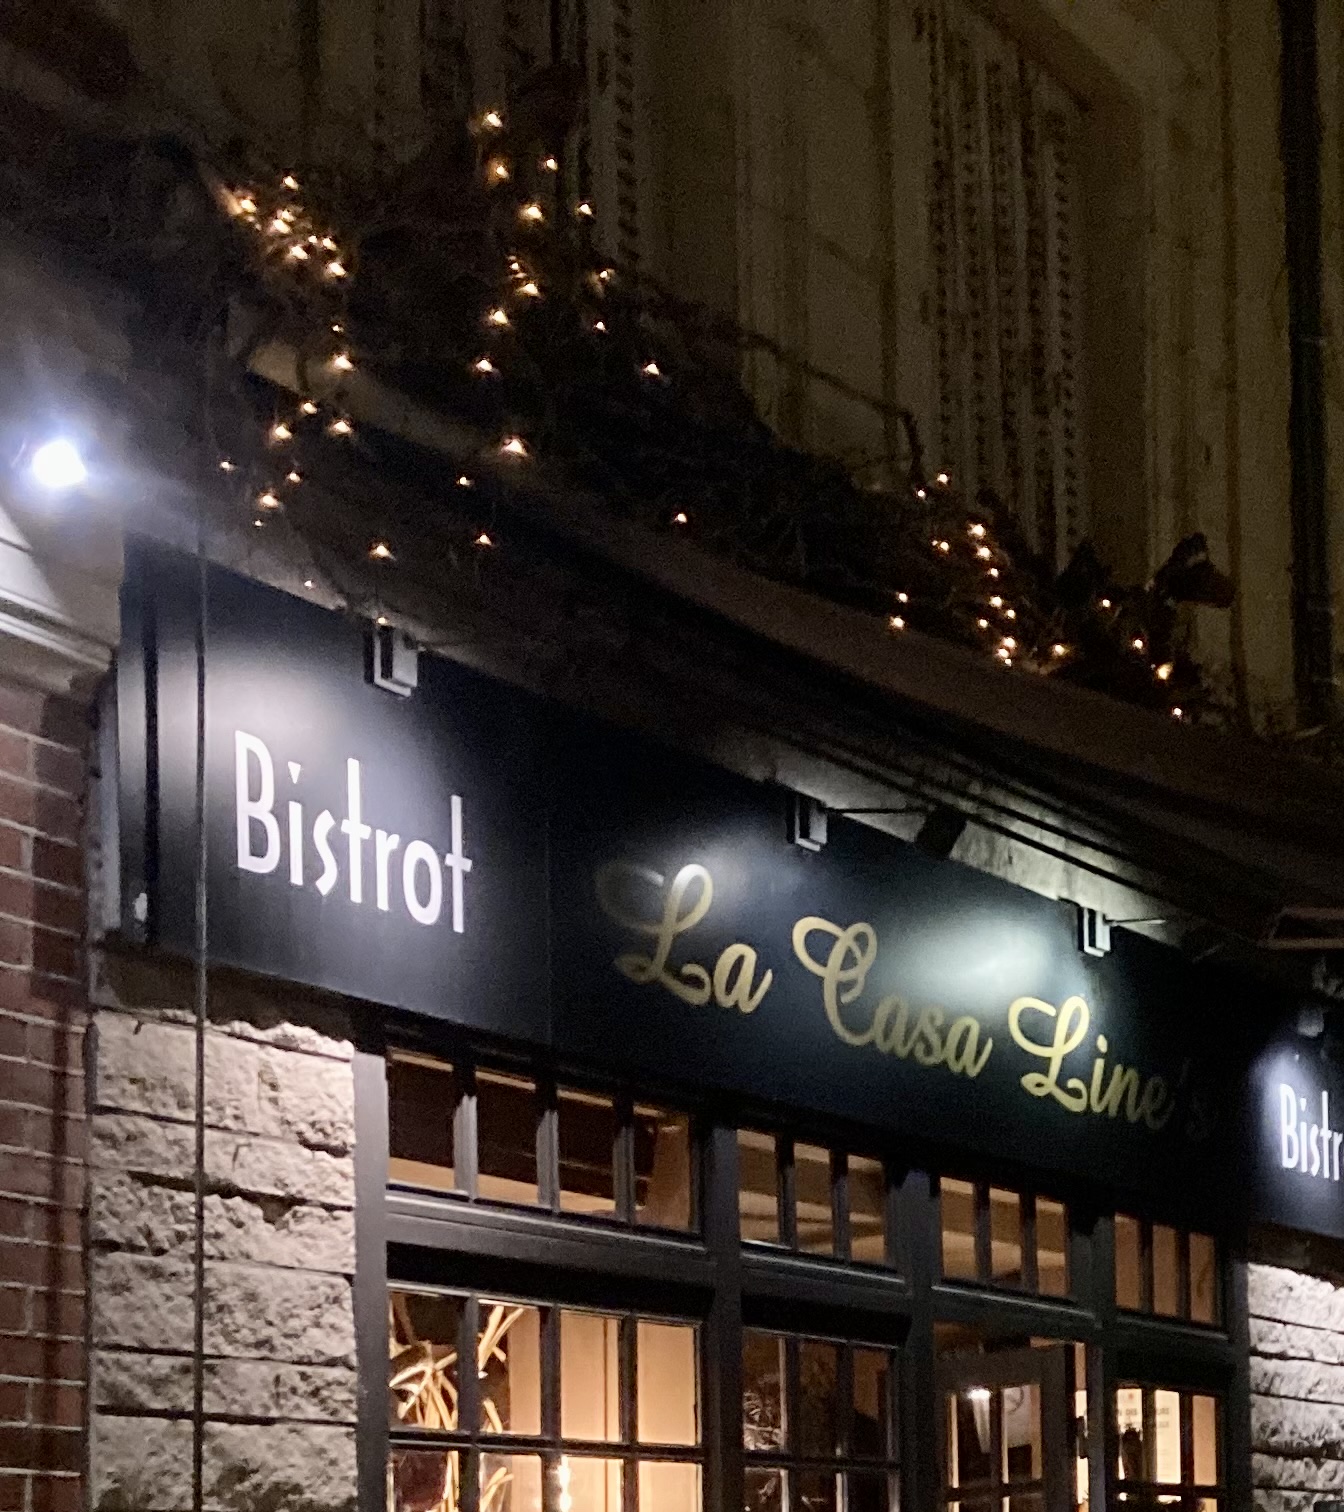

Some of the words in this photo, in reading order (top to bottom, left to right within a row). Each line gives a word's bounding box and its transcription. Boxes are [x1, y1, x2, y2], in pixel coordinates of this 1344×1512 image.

[234, 729, 473, 934] Bistrot
[597, 863, 773, 1014] La
[791, 915, 993, 1078] Casa
